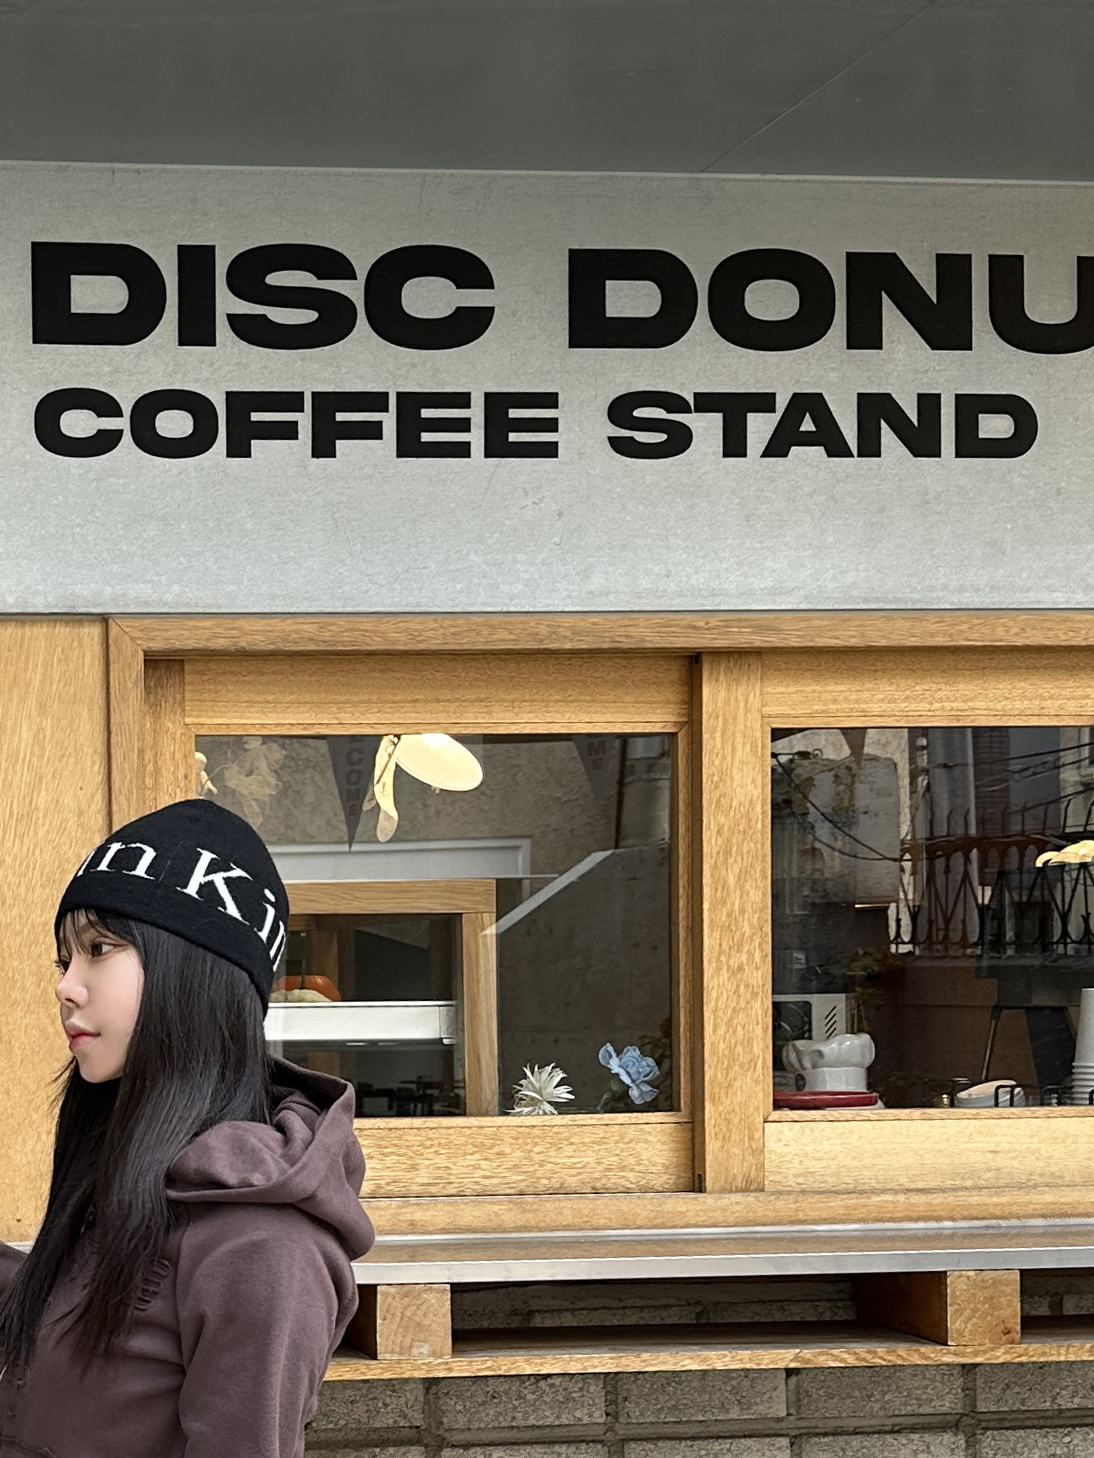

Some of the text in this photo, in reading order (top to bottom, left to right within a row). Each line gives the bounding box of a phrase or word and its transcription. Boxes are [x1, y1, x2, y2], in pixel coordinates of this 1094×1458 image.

[30, 240, 1094, 355] DISC DONU
[33, 386, 1039, 460] COFFEE STAND
[338, 734, 365, 816] COME
